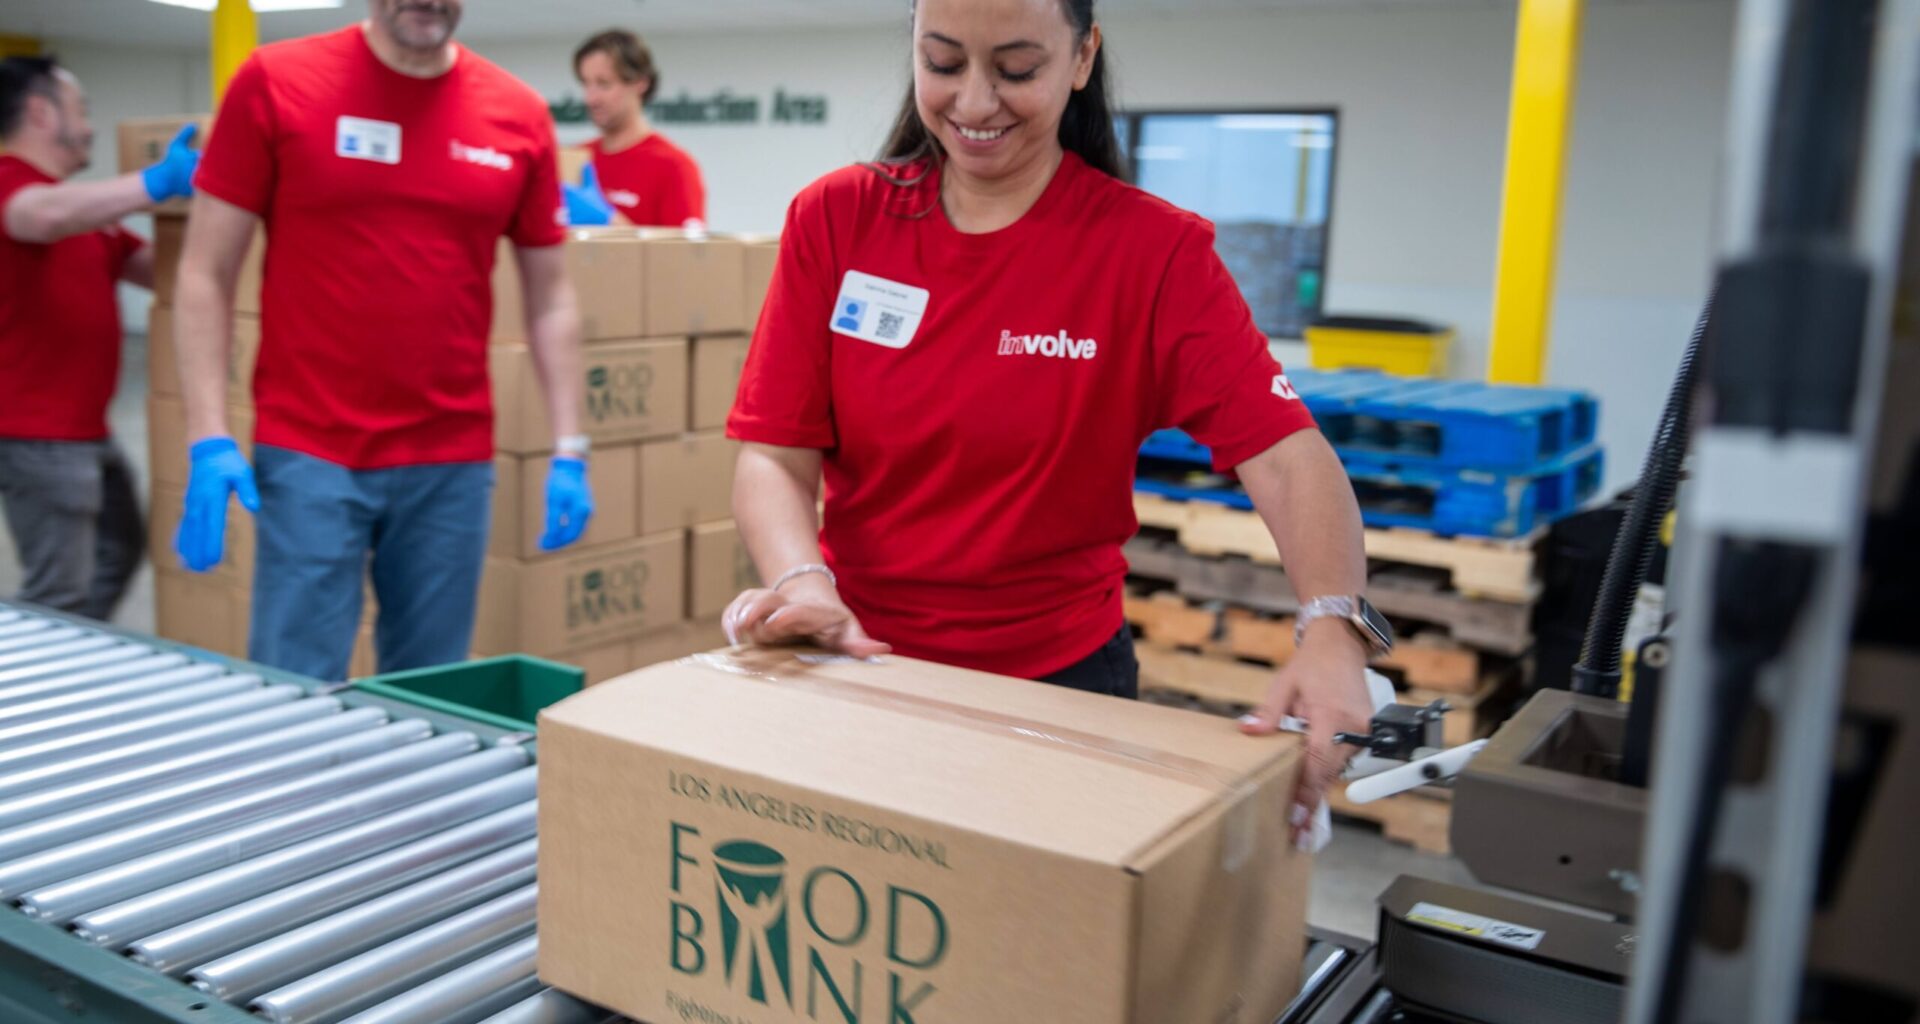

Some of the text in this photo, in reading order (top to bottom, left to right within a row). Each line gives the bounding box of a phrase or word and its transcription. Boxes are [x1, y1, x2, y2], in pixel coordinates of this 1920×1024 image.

[771, 87, 828, 125] Area
[997, 329, 1097, 360] involve
[668, 768, 954, 871] LOS ANGELES REGIONAL
[668, 820, 951, 971] FOOD
[667, 899, 940, 1024] BANK
